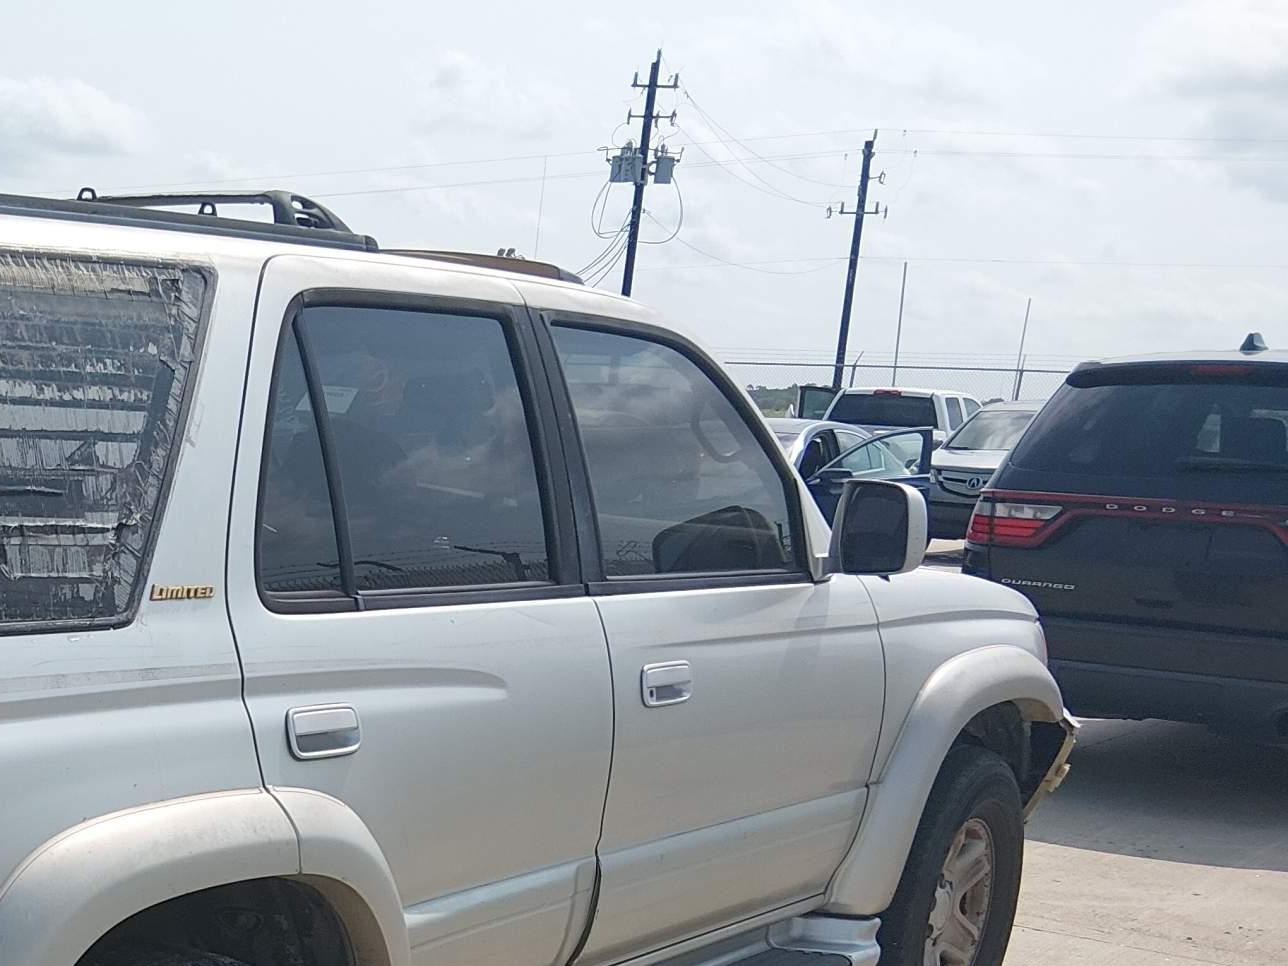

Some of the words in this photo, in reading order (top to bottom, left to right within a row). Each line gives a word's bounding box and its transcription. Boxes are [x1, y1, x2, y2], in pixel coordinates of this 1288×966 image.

[1105, 502, 1236, 518] DODGE
[1000, 577, 1077, 591] DURANGO
[150, 583, 216, 602] LIMITED
